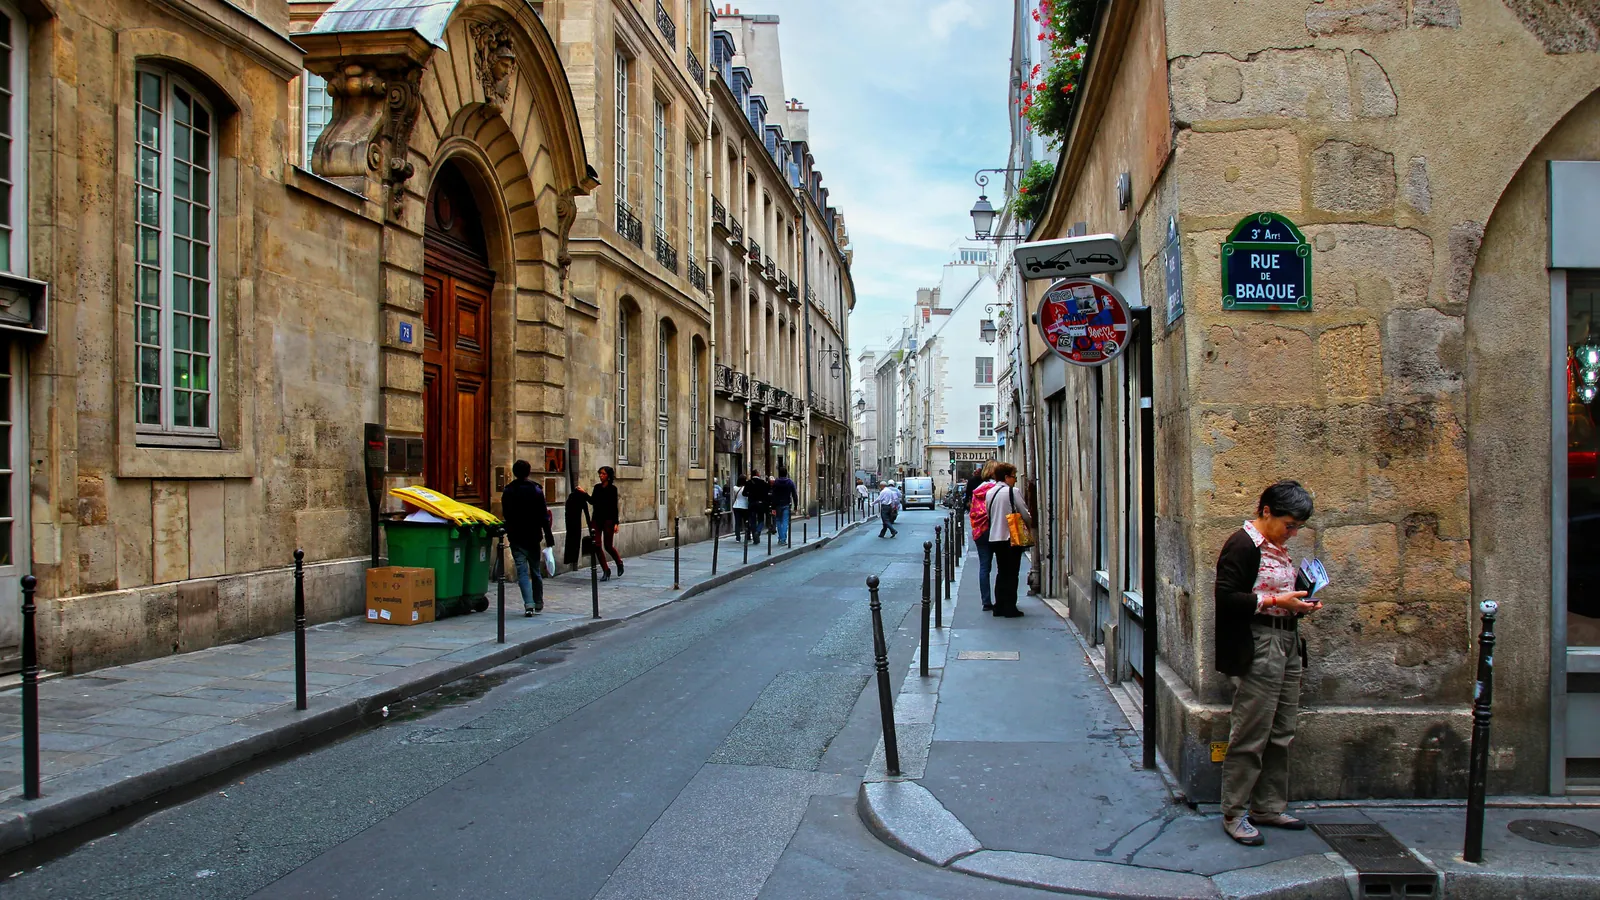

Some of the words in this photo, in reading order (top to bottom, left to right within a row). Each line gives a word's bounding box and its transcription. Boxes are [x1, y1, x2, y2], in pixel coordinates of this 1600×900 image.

[1250, 253, 1280, 269] RUE
[1260, 272, 1271, 281] DE
[1235, 283, 1296, 300] BRAQUE
